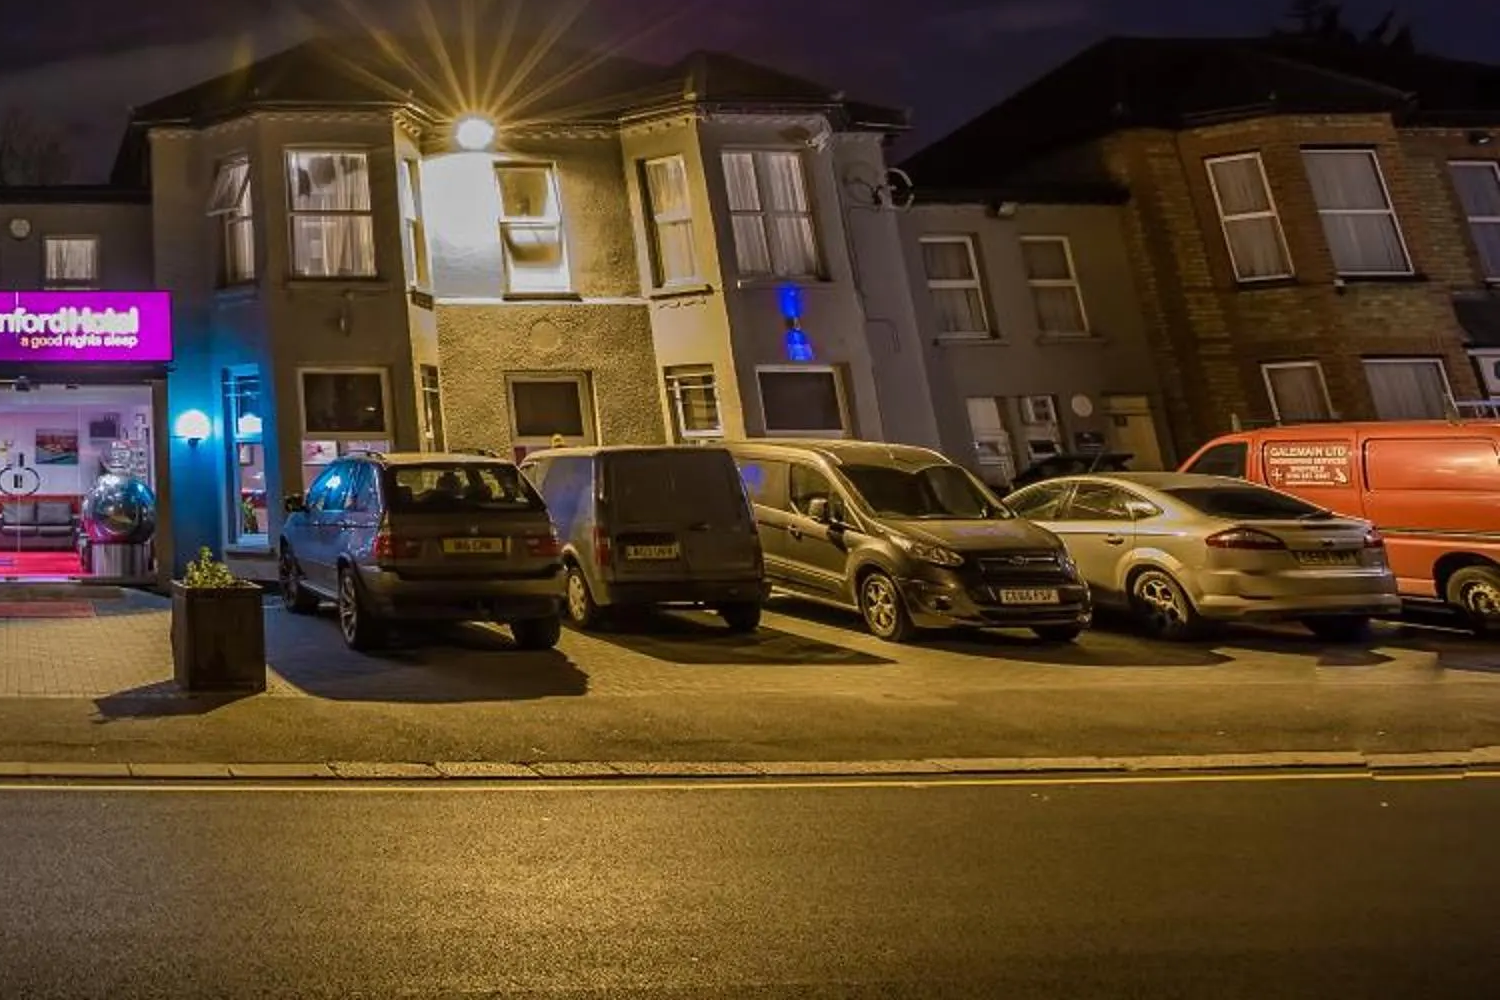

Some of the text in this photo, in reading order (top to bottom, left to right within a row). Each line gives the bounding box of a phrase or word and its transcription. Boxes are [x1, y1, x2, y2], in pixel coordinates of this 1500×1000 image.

[20, 334, 139, 349] a good nights sleep
[1326, 446, 1346, 457] LTD
